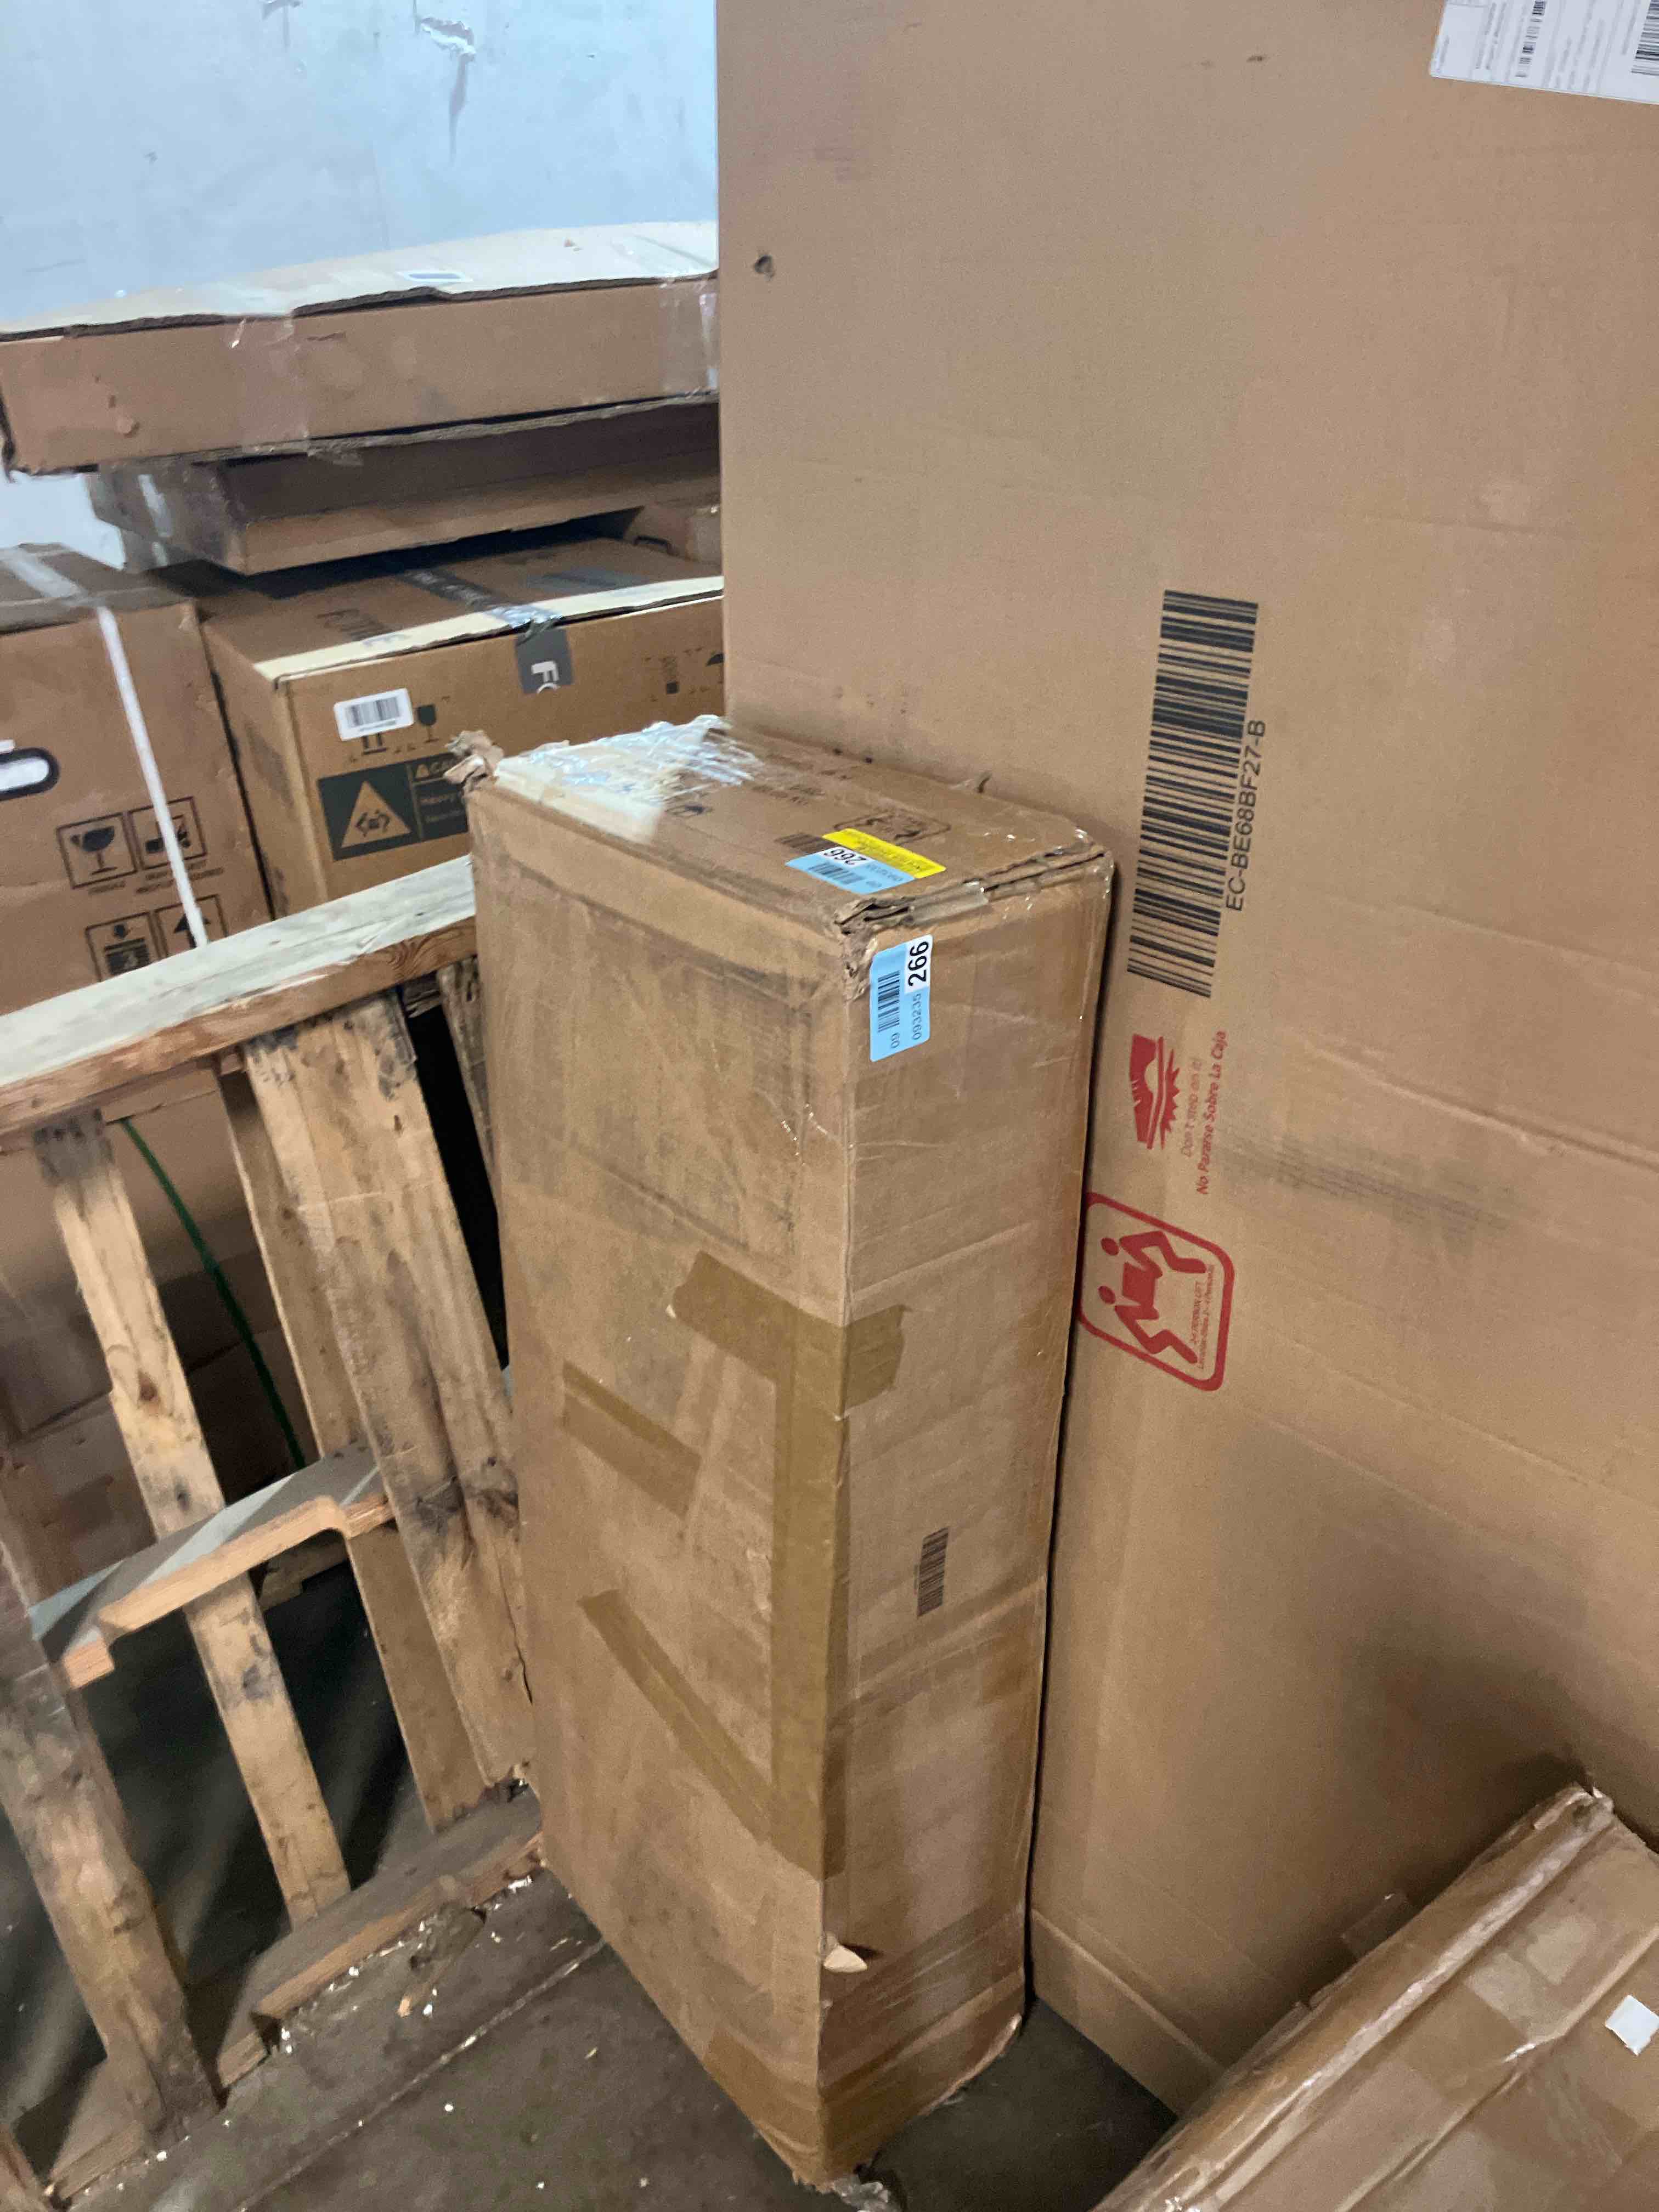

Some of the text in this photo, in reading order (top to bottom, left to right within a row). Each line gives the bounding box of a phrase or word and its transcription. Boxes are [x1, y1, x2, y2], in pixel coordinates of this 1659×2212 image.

[1226, 720, 1266, 912] EC-BE68BF27-B
[824, 848, 867, 865] 266
[908, 940, 929, 987] 266
[890, 1032, 900, 1048] 09
[1196, 1176, 1209, 1194] No
